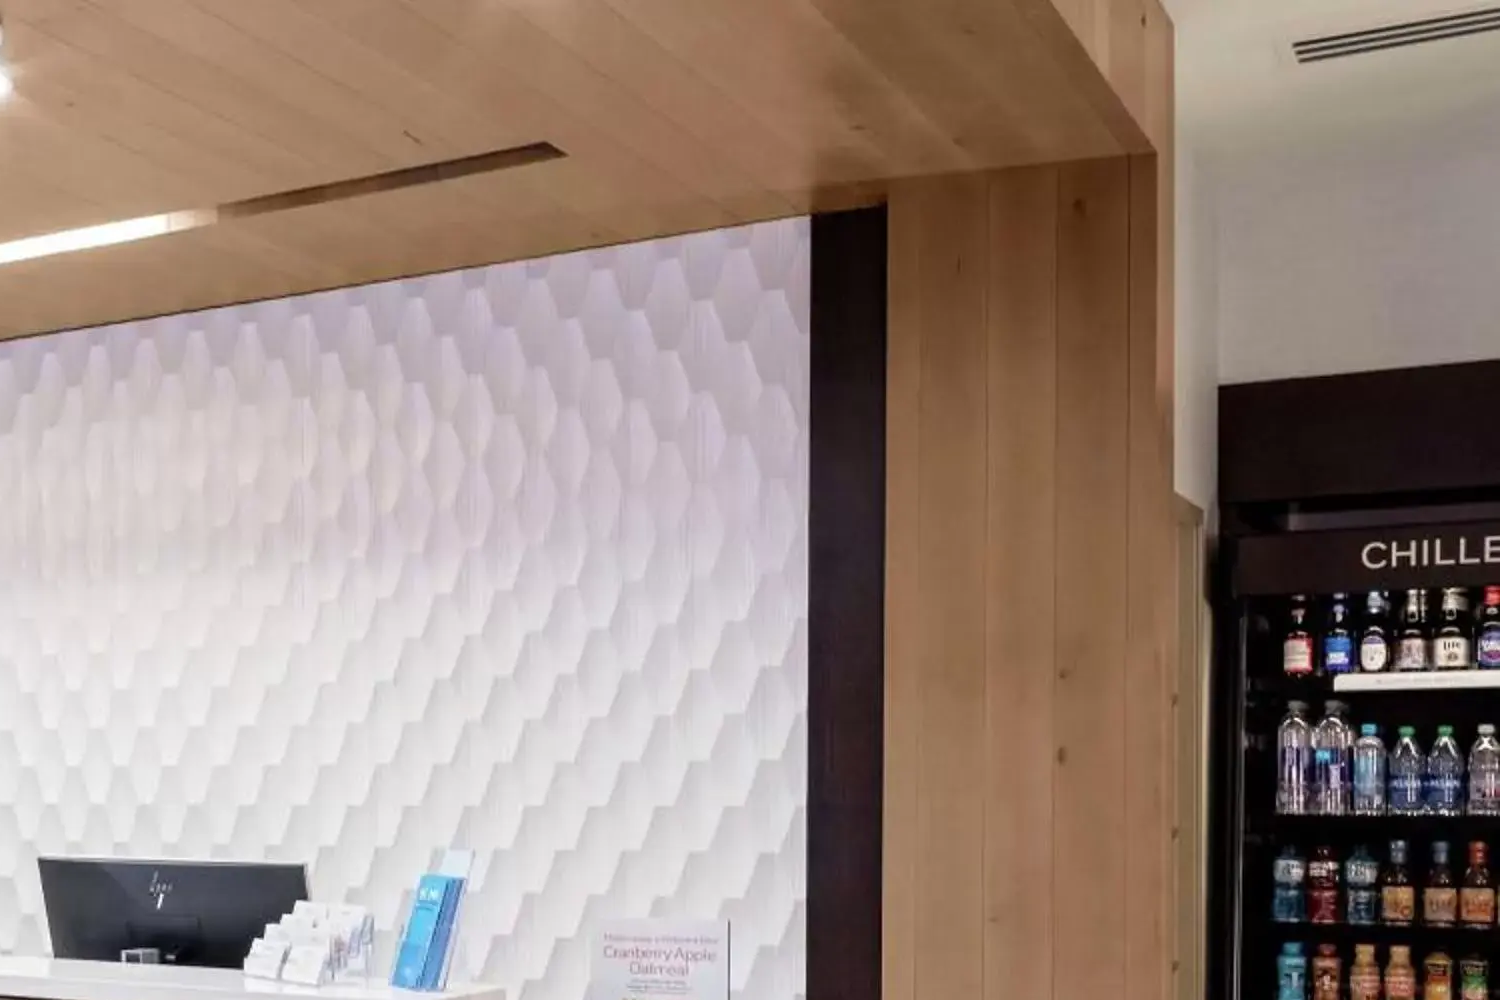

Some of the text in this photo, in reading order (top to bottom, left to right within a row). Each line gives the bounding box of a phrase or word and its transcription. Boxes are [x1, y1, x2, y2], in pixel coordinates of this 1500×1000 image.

[603, 945, 718, 965] Cranberry Apple
[629, 961, 690, 977] Oatmeal
